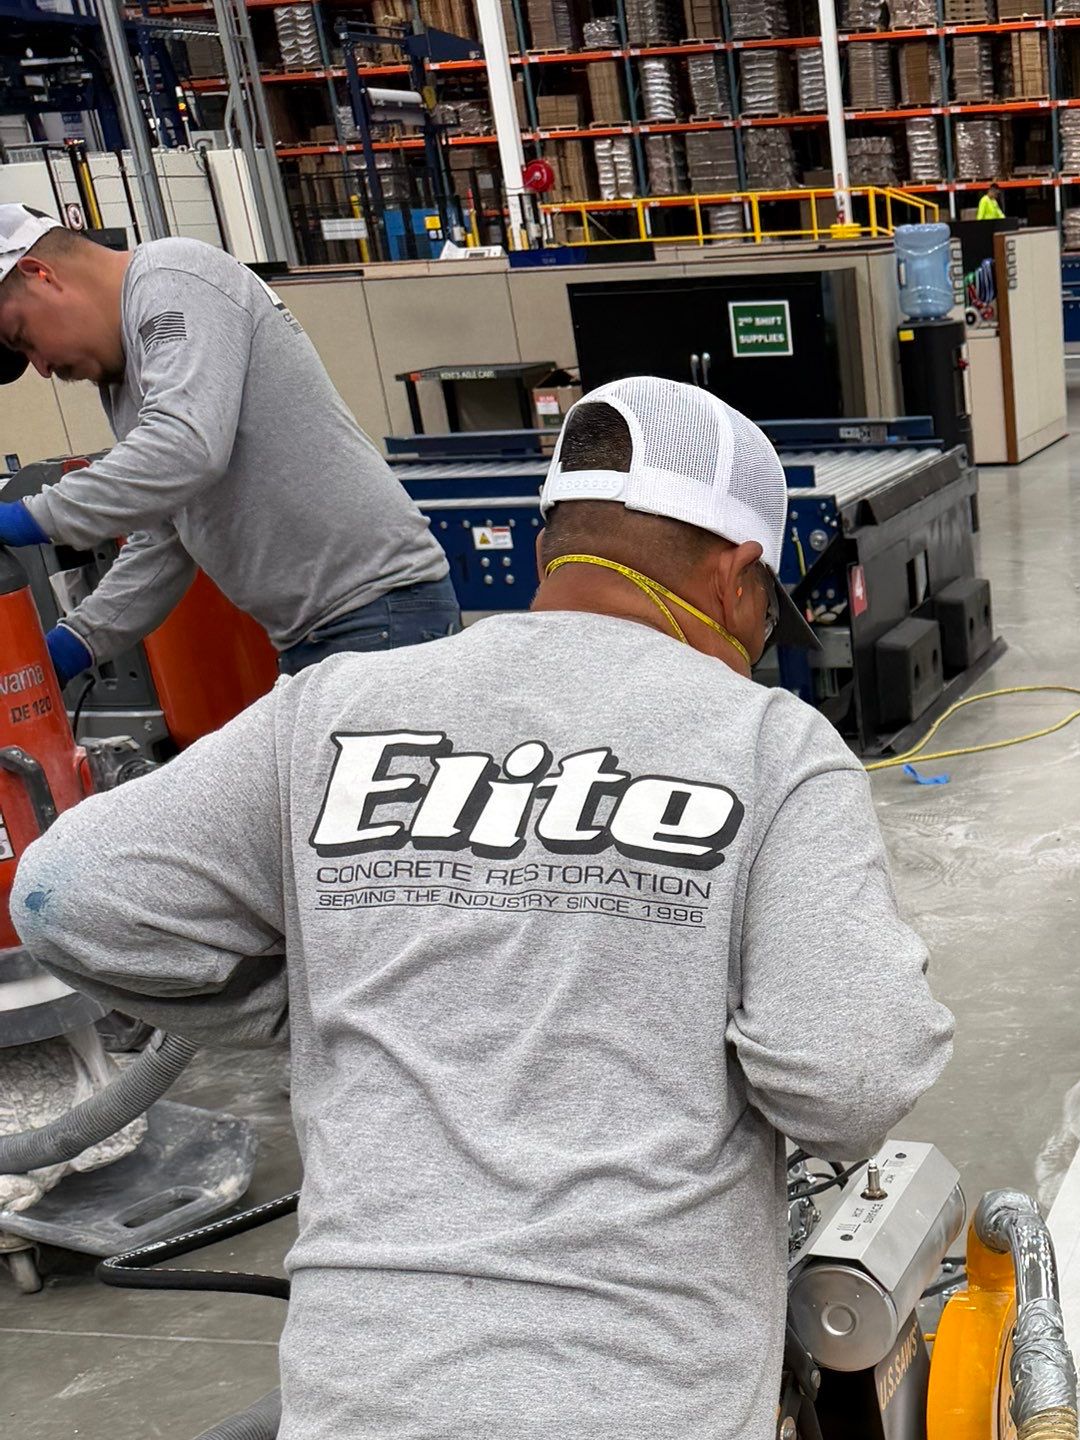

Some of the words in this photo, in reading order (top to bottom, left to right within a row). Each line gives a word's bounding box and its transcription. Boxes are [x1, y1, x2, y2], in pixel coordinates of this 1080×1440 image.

[754, 316, 782, 326] SHIFT
[739, 333, 785, 343] SUPPLIES
[11, 704, 31, 723] DE
[32, 696, 52, 716] 120
[309, 730, 744, 870] Elite
[316, 860, 473, 884] CONCRETE
[485, 863, 712, 899] RESTORATION
[318, 889, 396, 907] SERVING
[403, 889, 441, 903] THE
[449, 891, 560, 909] INDUSTRY
[566, 895, 631, 914] SINCE
[641, 904, 704, 923] 1996
